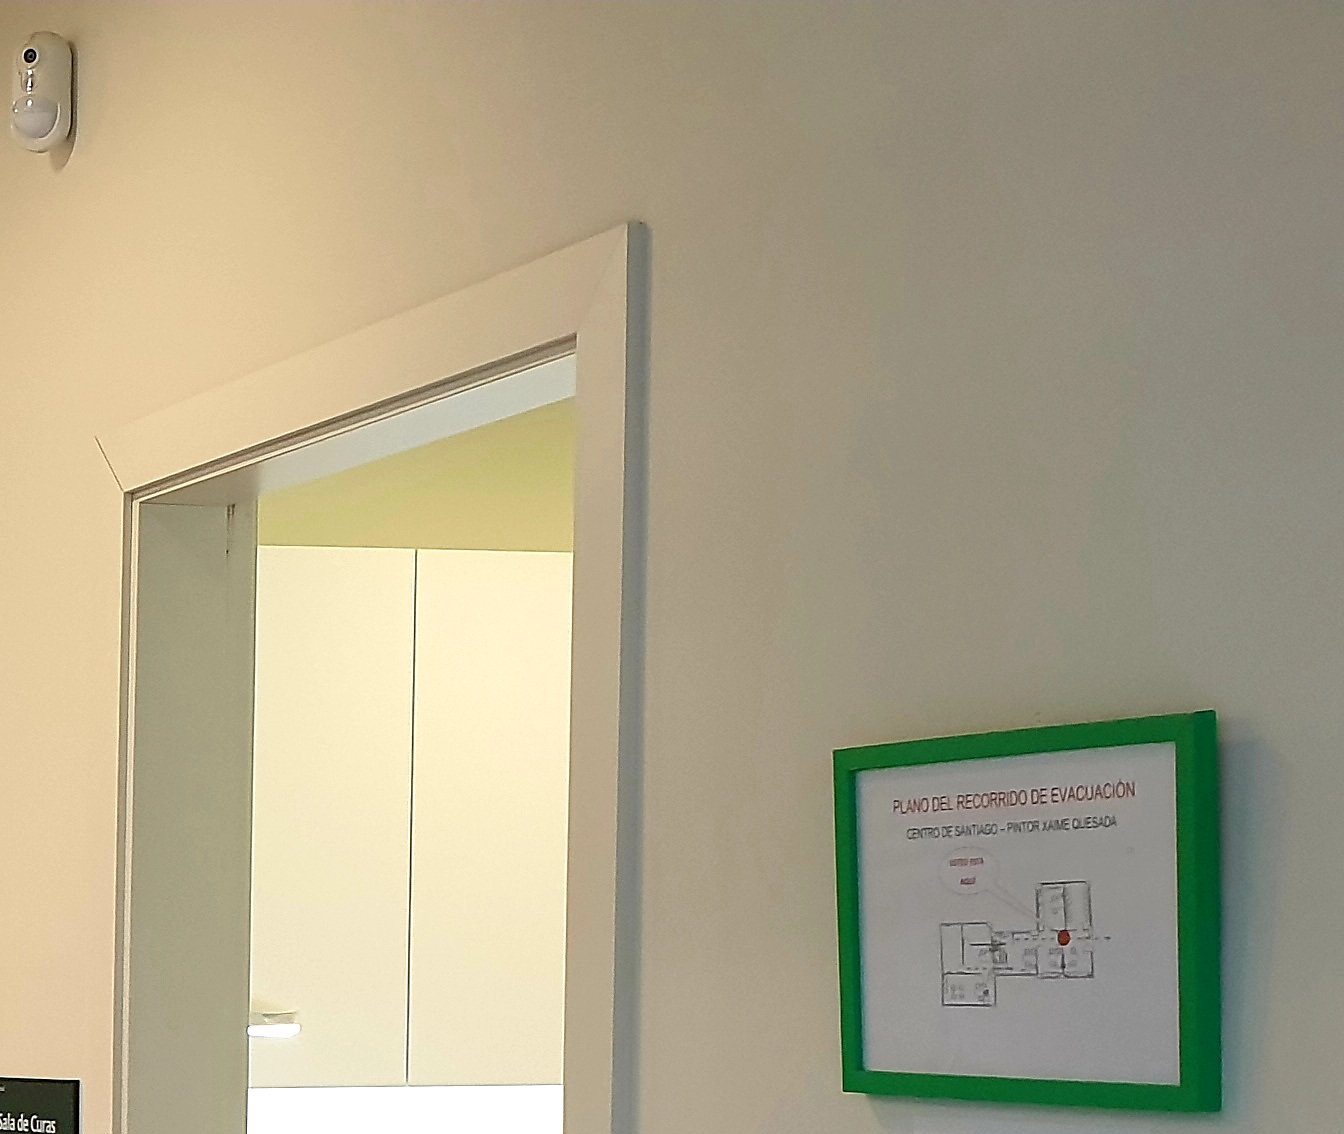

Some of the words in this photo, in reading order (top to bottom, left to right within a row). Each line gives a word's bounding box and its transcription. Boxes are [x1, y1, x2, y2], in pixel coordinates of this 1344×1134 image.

[892, 798, 929, 814] PLANO
[931, 796, 954, 811] DEL
[956, 790, 1028, 810] RECORRIDO
[1030, 789, 1048, 805] DE
[1051, 780, 1136, 802] EVACUACIÓN
[906, 826, 941, 840] CENTRO
[941, 826, 954, 838] DE
[954, 823, 998, 837] SANTIAGO
[1006, 819, 1040, 833] PINTOR
[1042, 818, 1070, 832] XAIME
[1072, 815, 1118, 831] QUESADA
[17, 1113, 29, 1132] de
[31, 1115, 56, 1134] Curas
